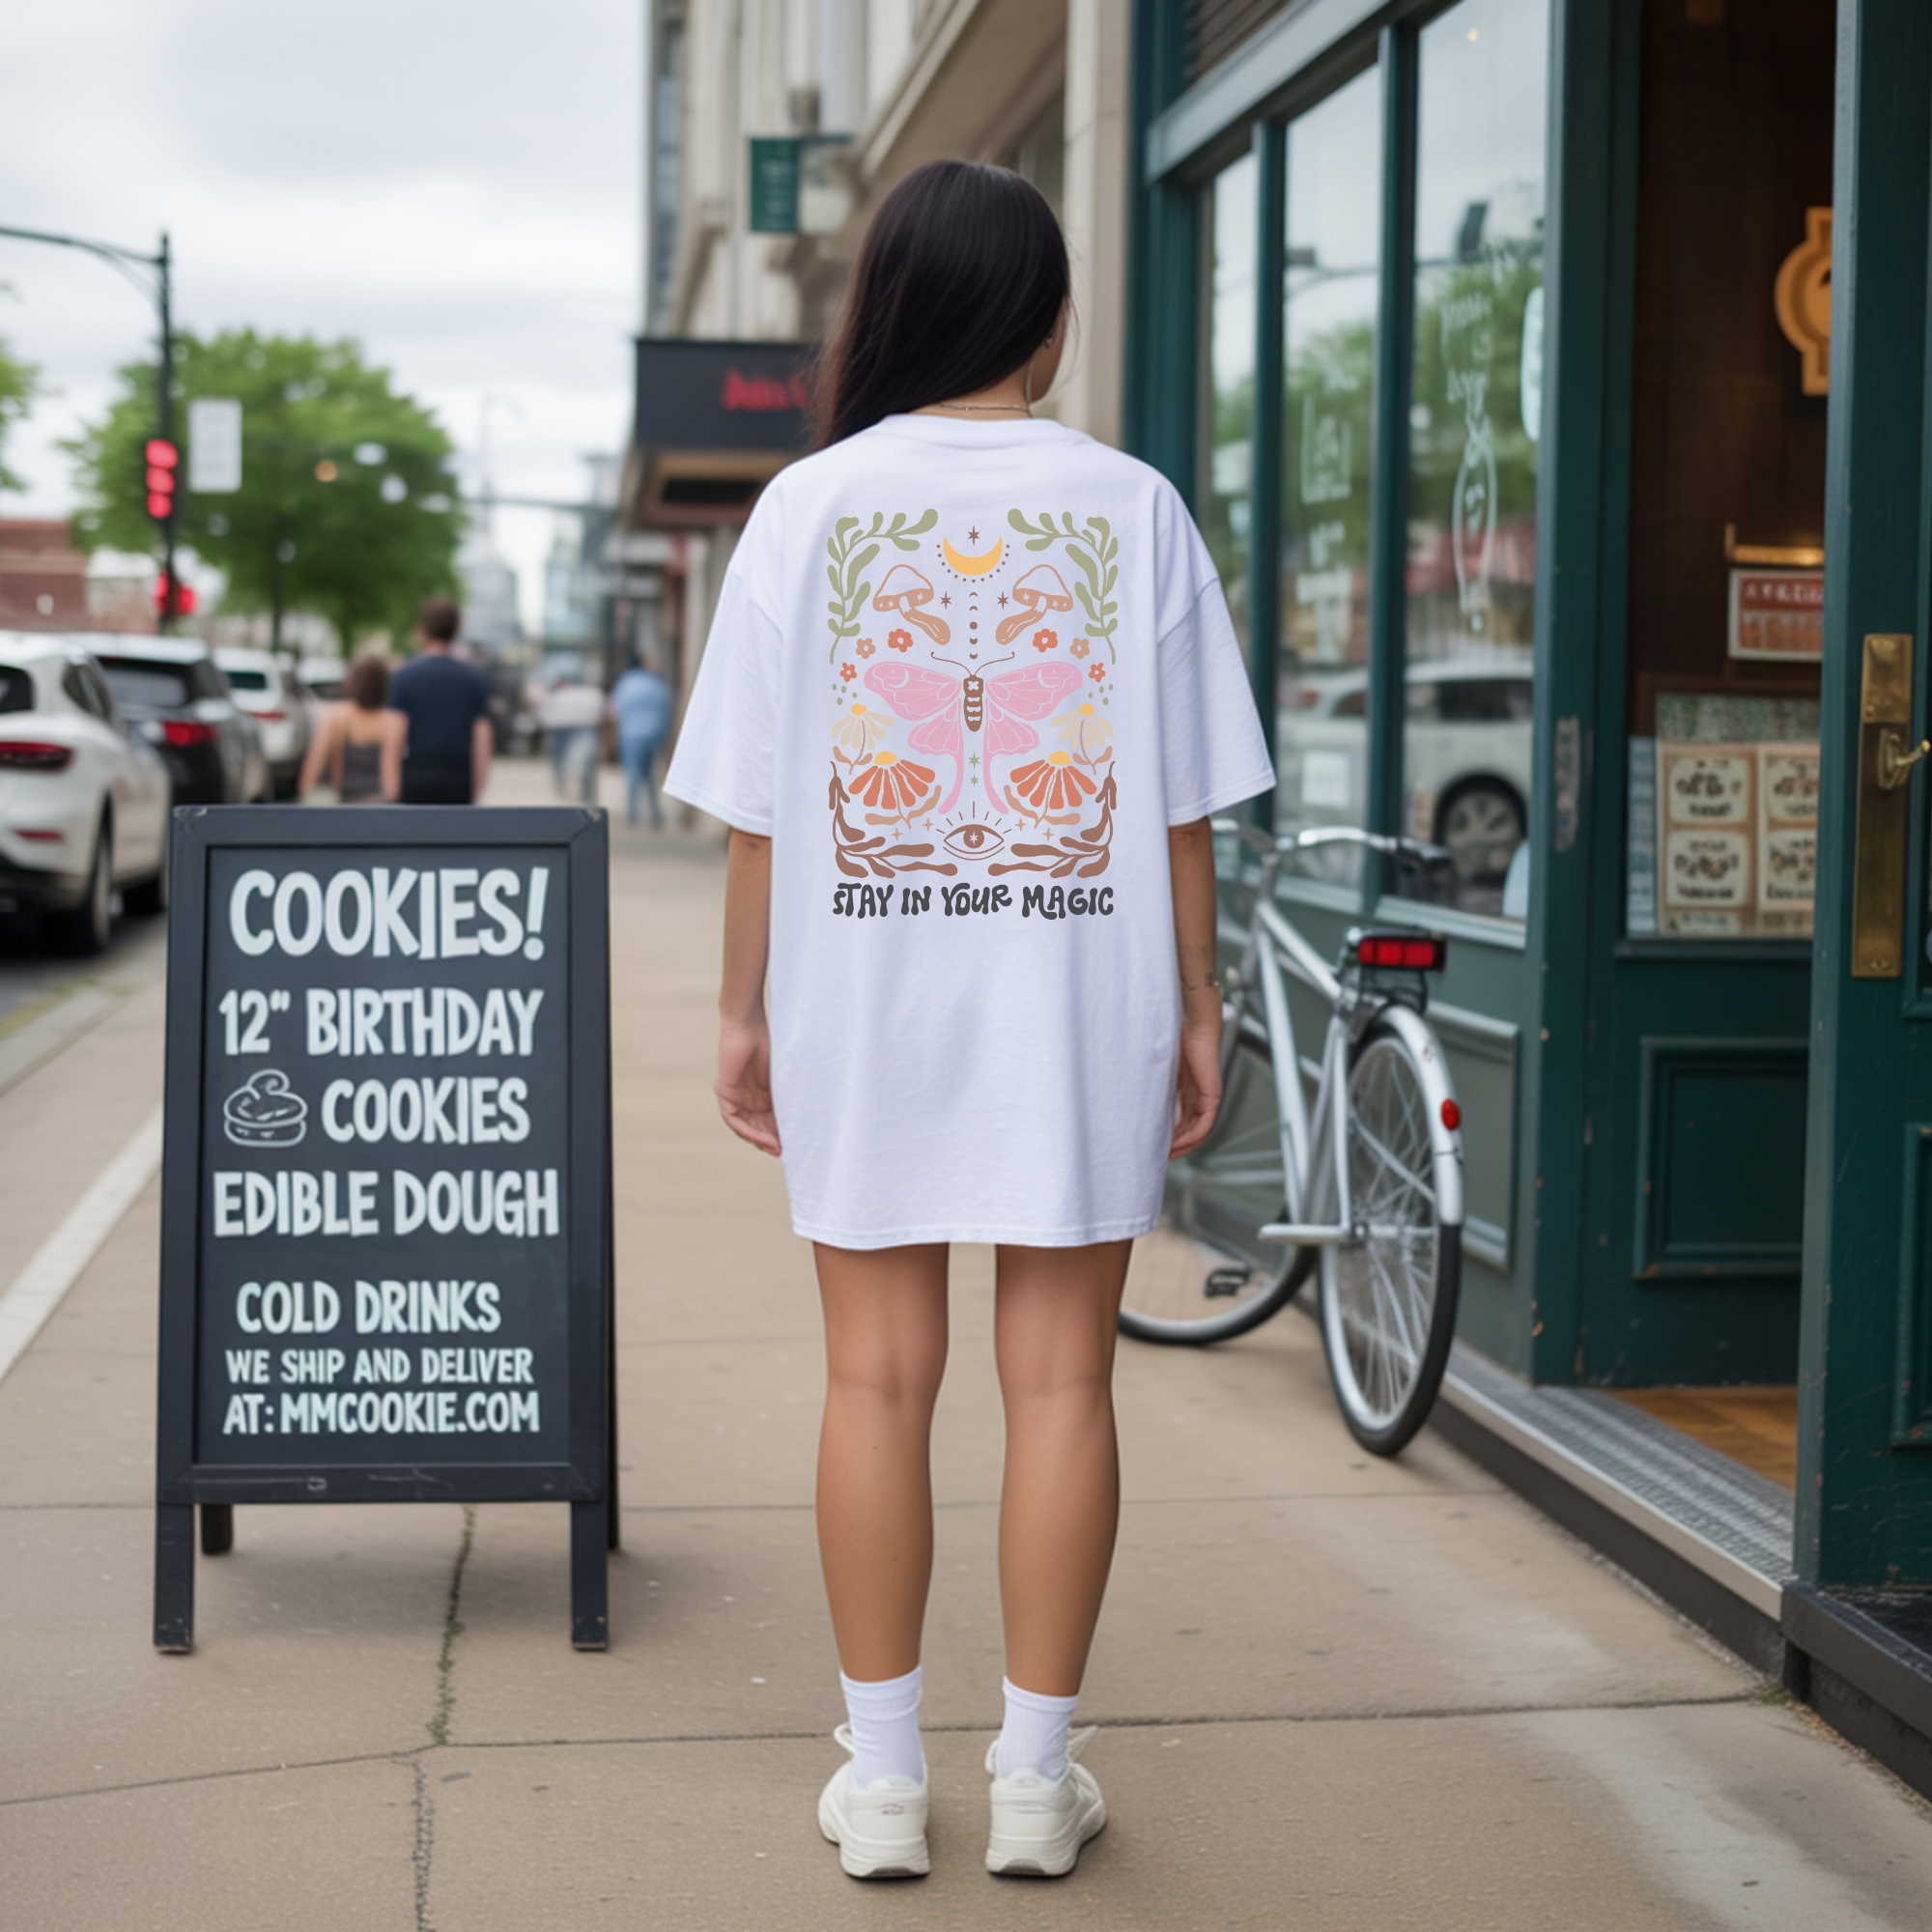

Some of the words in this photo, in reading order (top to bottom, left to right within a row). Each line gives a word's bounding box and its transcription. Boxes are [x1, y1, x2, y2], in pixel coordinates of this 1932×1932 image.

[230, 867, 550, 961] COOKIES!
[833, 883, 895, 920] STAY
[900, 886, 932, 916] IN
[941, 883, 1013, 917] YOUR
[1022, 885, 1115, 921] MAGIC
[305, 986, 545, 1057] BIRTHDAY
[321, 1076, 530, 1146] COOKIES
[213, 1170, 380, 1237] EDIBLE
[393, 1168, 559, 1238] DOUGH
[236, 1280, 341, 1335] COLD
[355, 1280, 502, 1335] DRINKS
[225, 1349, 270, 1384] WE
[280, 1348, 346, 1384] SHIP
[353, 1348, 412, 1384] AND
[420, 1347, 534, 1384] DELIVER
[280, 1390, 540, 1435] MMCOOKIE.COM
